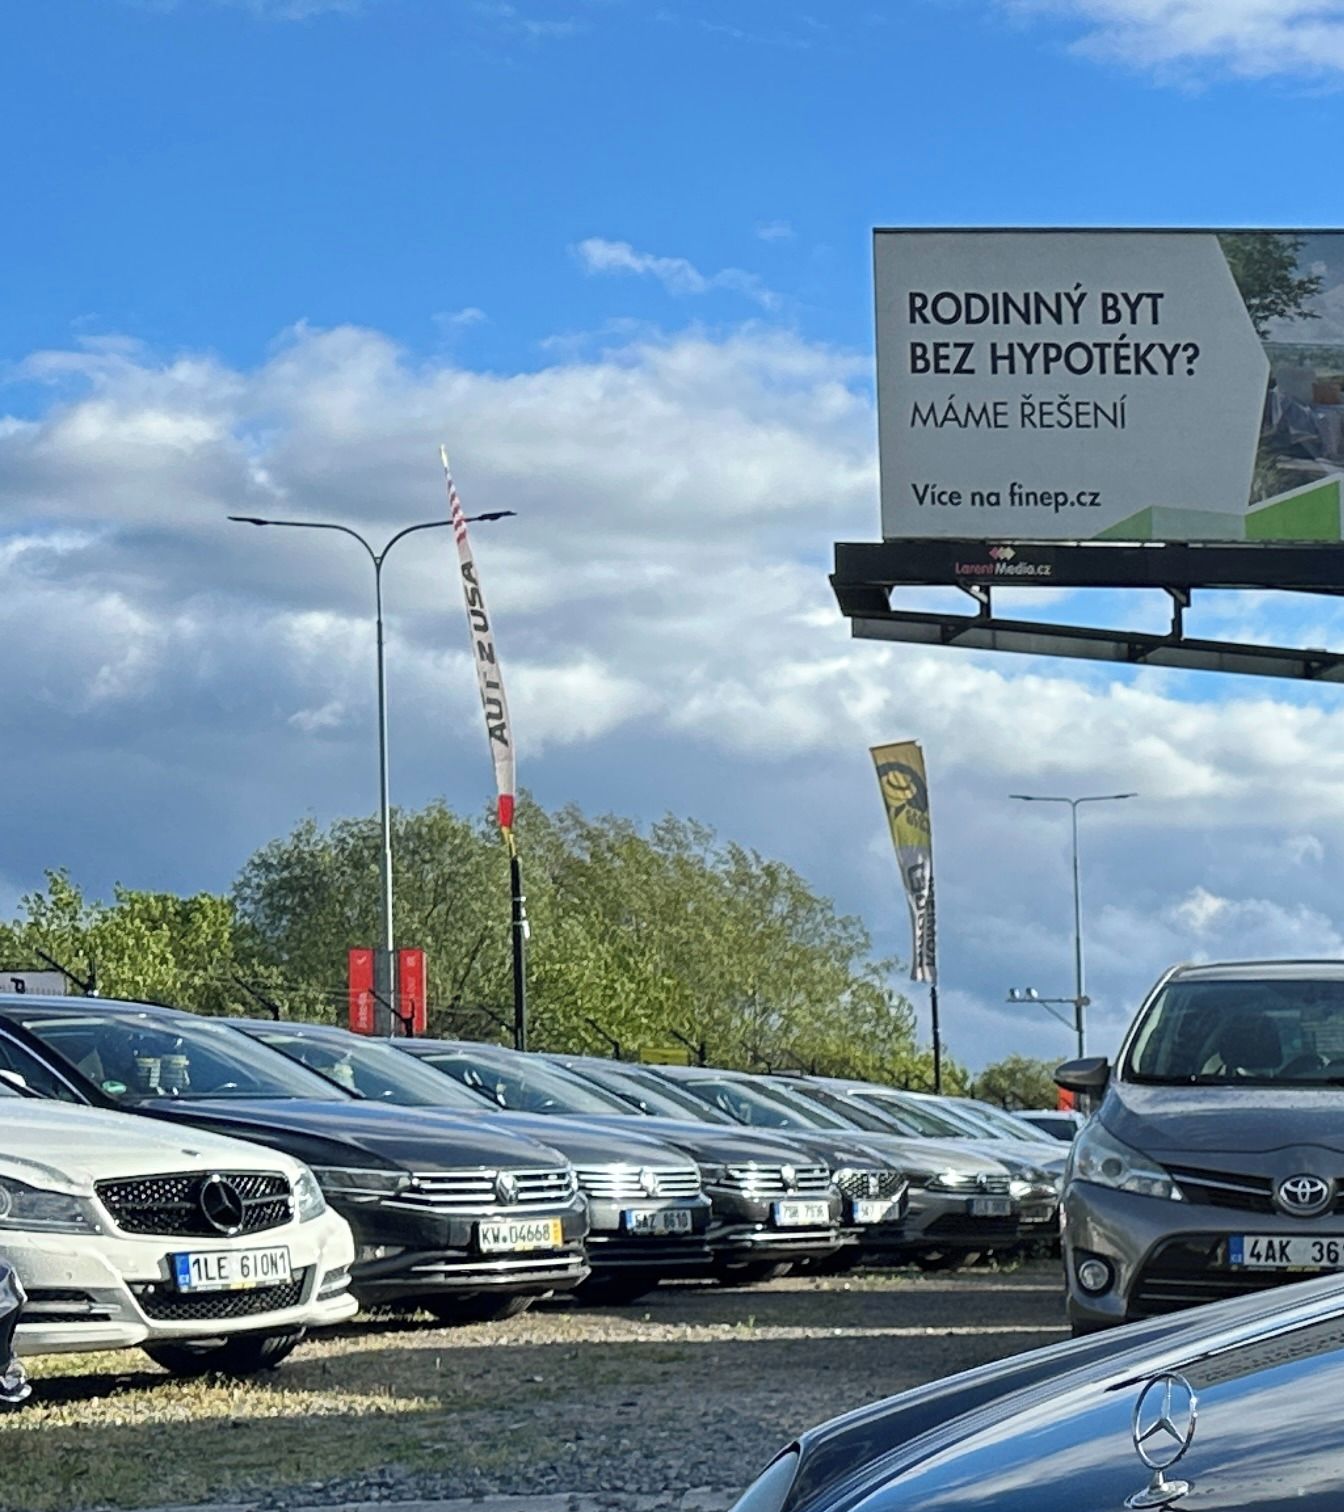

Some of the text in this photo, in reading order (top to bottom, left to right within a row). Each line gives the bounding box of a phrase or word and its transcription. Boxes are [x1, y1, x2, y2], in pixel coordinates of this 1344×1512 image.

[908, 282, 1165, 325] RODINNÝ BYT
[910, 333, 1200, 376] BEZ HYPOTÉKY?
[910, 394, 1127, 429] MÁME ŘEŠENÍ
[911, 482, 1101, 513] Více na finep.cz
[461, 560, 489, 633] USA
[477, 640, 495, 664] Z
[1250, 1239, 1291, 1263] 4AK
[192, 1256, 230, 1281] 1LE
